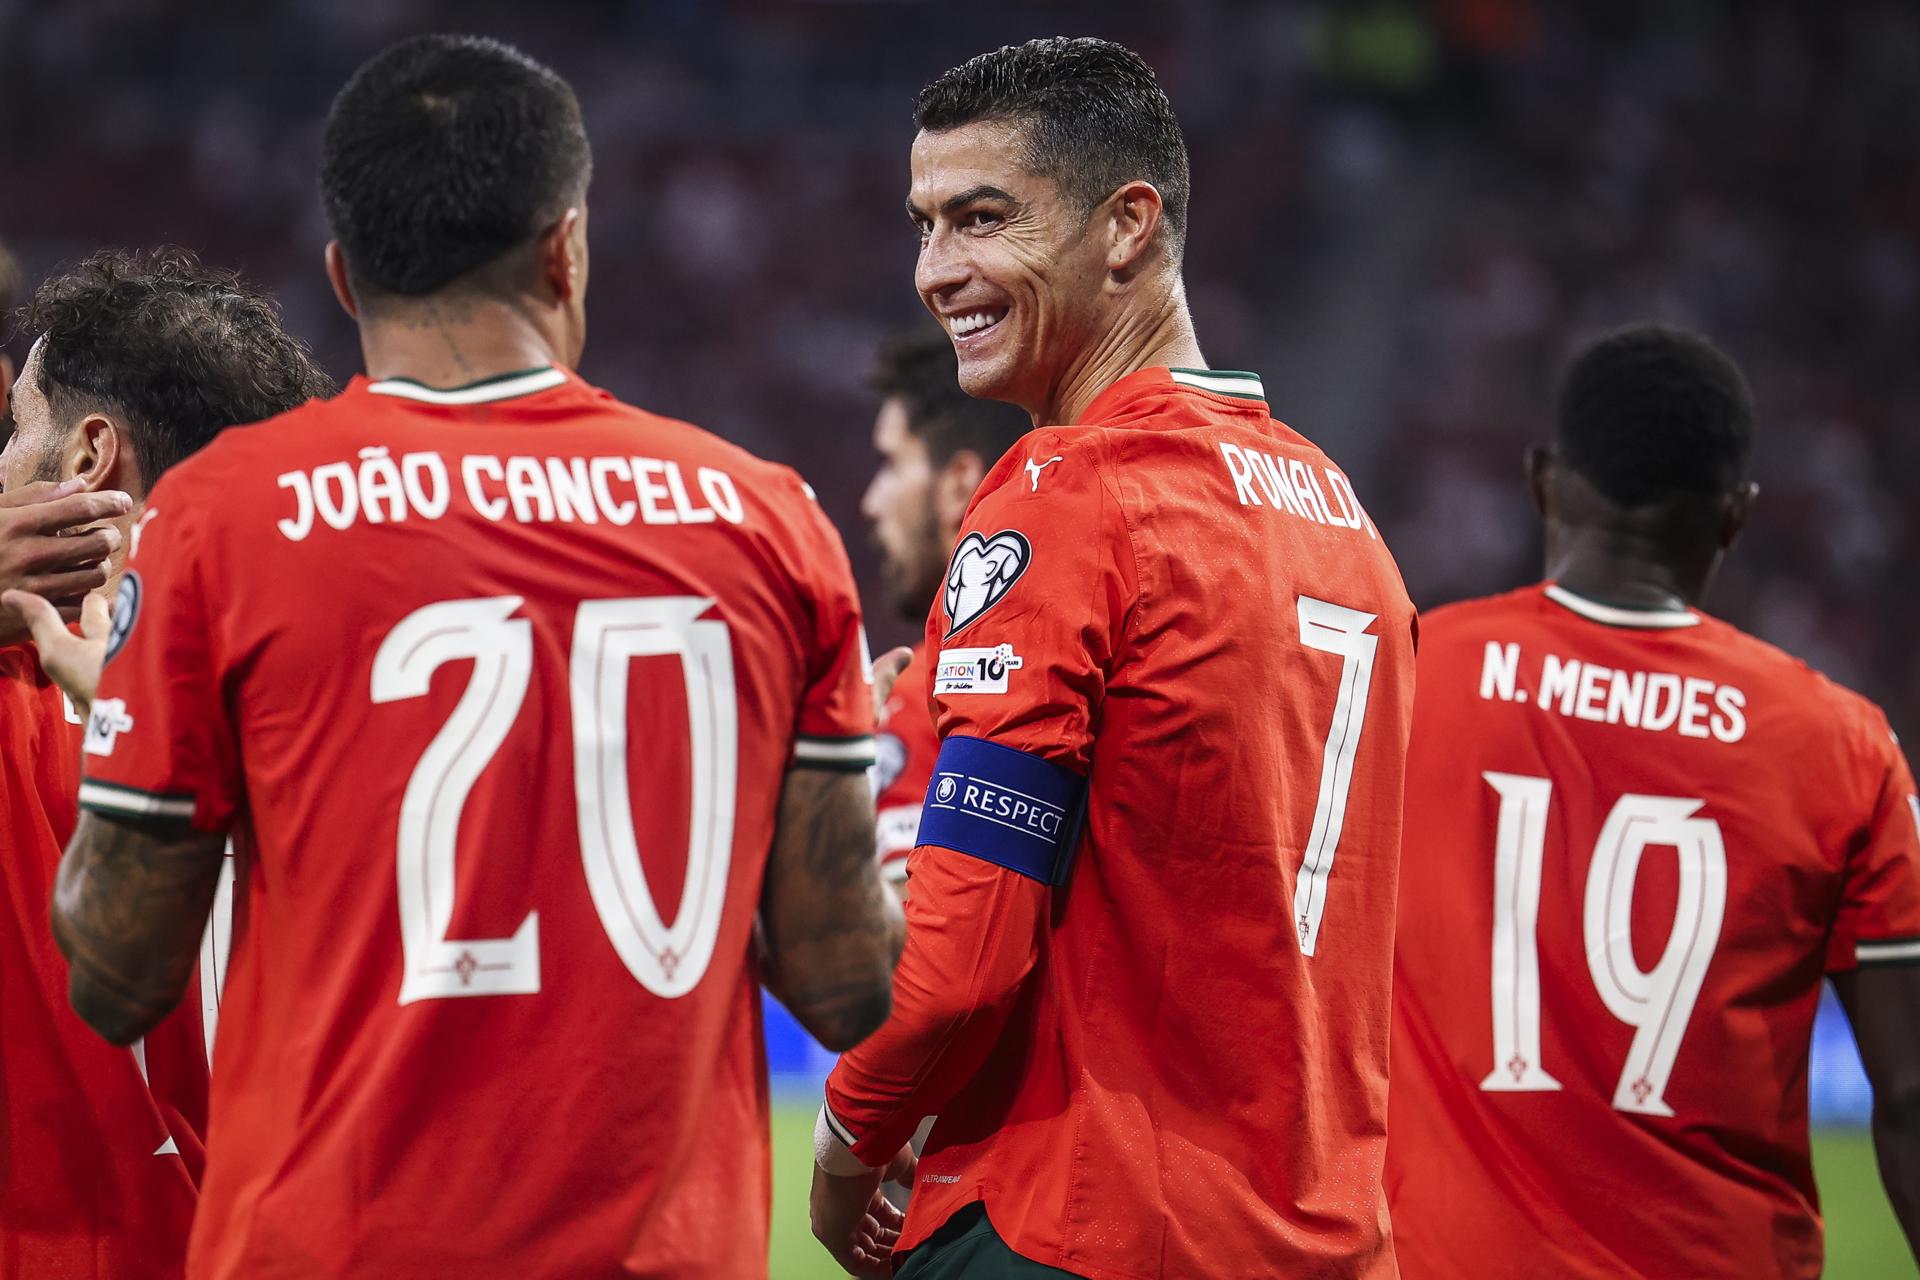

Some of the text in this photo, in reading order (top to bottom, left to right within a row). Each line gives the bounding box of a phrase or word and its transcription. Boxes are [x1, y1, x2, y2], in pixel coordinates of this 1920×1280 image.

[277, 446, 745, 541] JOÃO CANCELO
[976, 657, 1005, 681] 10
[1480, 641, 1747, 743] N. MENDES
[371, 595, 738, 1005] 20
[963, 785, 1063, 835] RESPECT
[1293, 594, 1378, 957] 7
[1481, 771, 1727, 1116] 19
